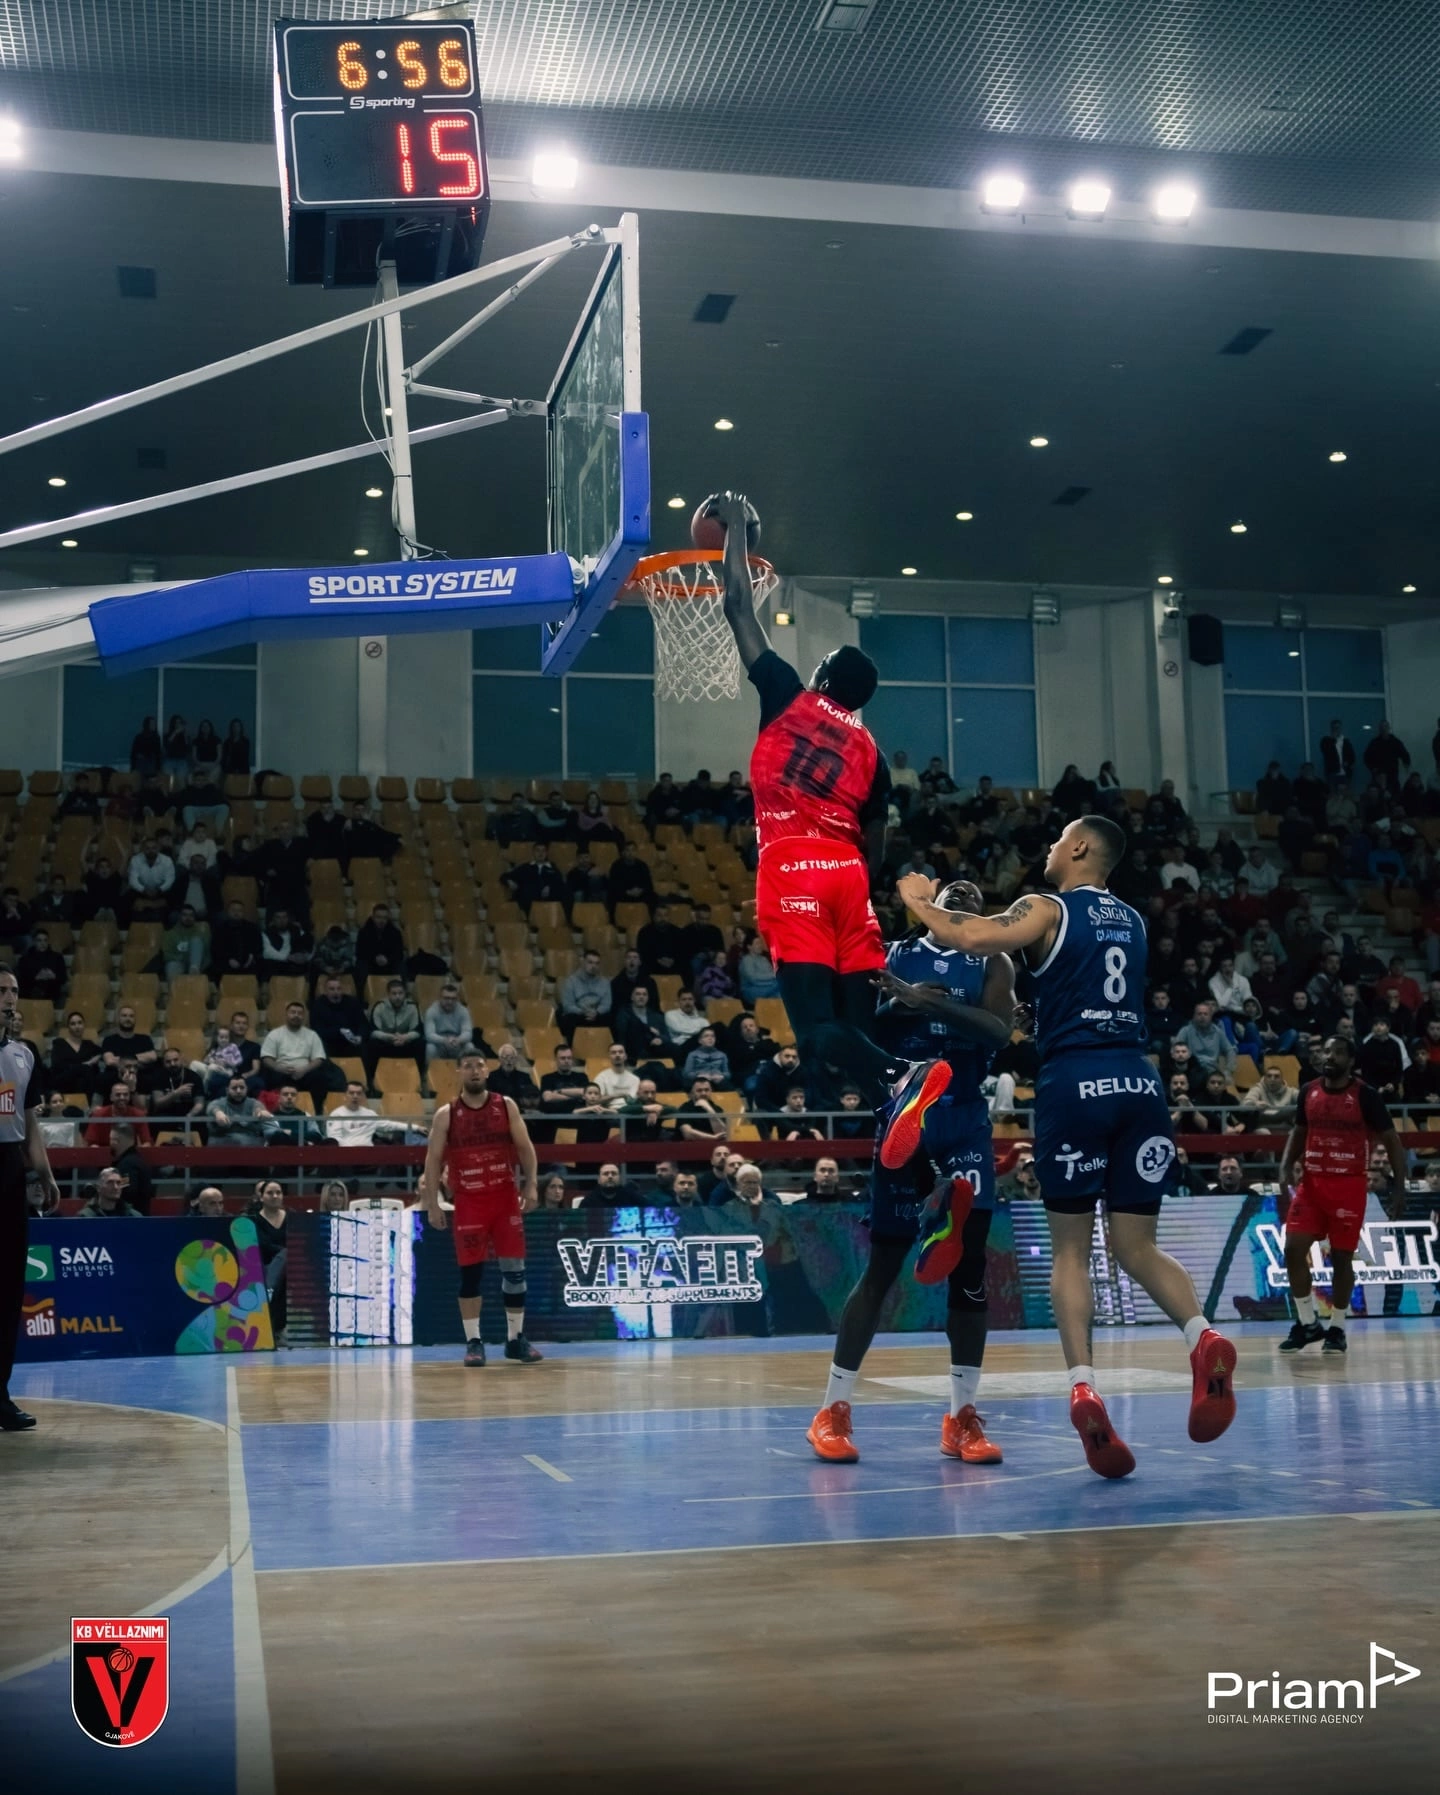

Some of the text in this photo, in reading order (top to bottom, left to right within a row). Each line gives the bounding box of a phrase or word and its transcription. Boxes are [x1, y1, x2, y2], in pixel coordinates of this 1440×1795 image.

[337, 41, 468, 89] 6:56
[366, 97, 416, 110] sporting
[399, 119, 477, 195] 15
[308, 567, 517, 599] SPORT SYSTEM
[1100, 906, 1132, 922] SIGAL
[1103, 946, 1127, 1003] 8
[1078, 1077, 1159, 1099] RELUX
[60, 1247, 113, 1265] SAVA
[558, 1237, 763, 1288] VITAFIT
[62, 1264, 114, 1272] INSURANCE
[1360, 1269, 1438, 1283] SUPPLEMENTS
[26, 1310, 56, 1336] albi
[60, 1315, 124, 1334] MALL
